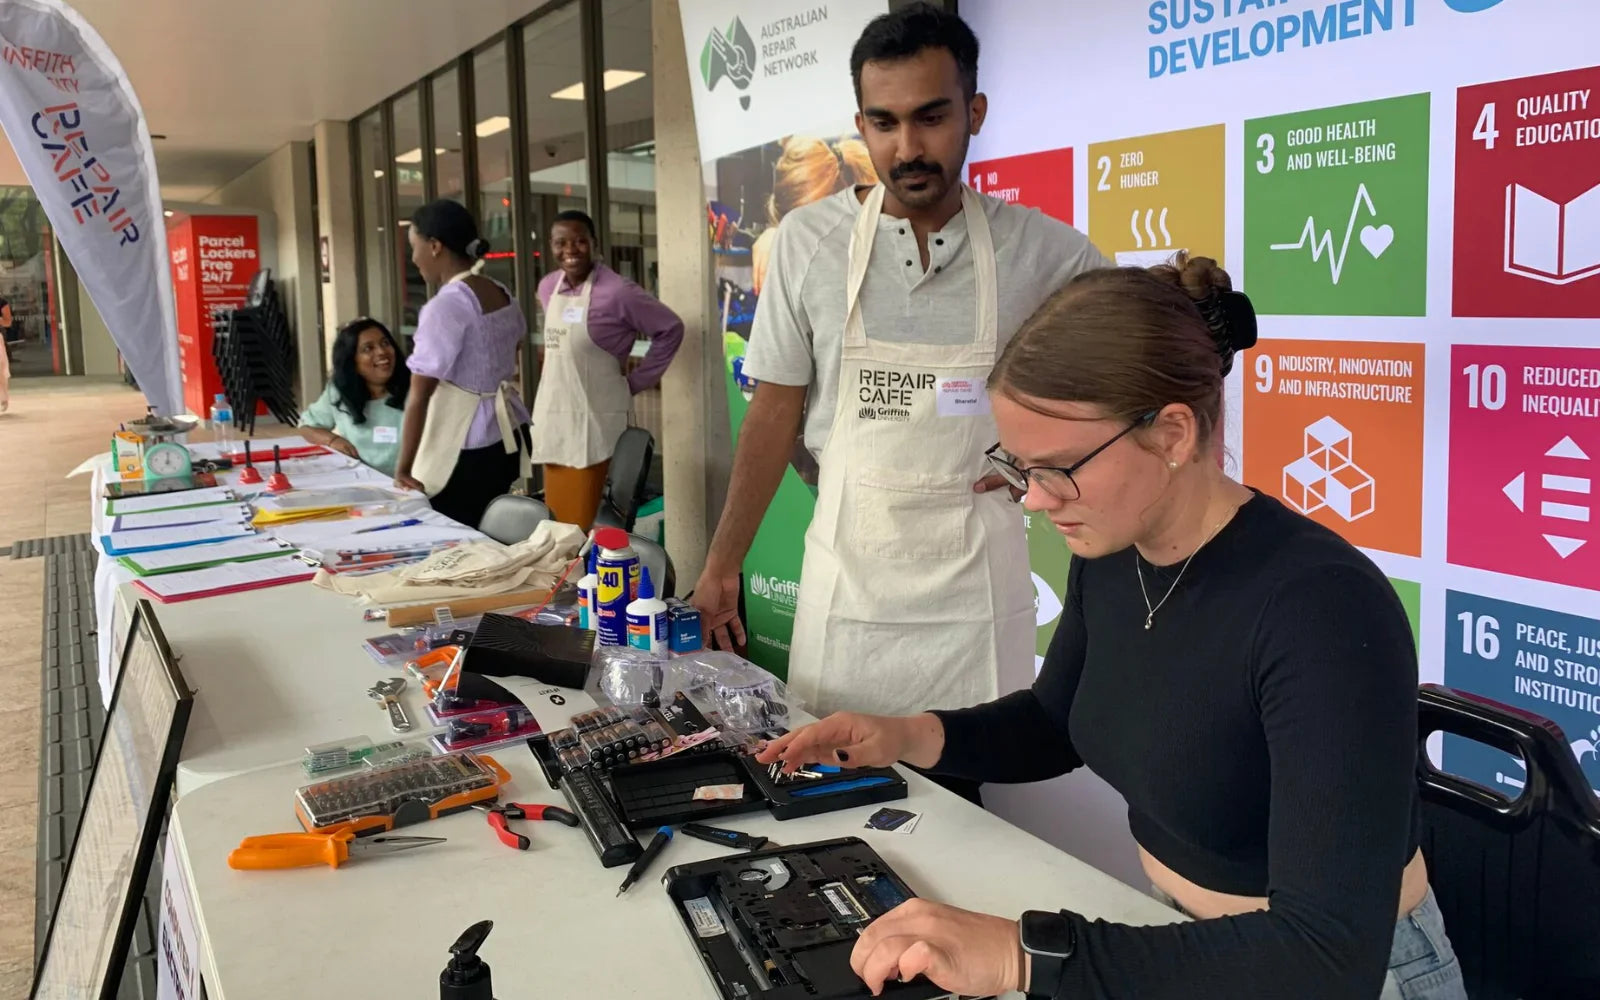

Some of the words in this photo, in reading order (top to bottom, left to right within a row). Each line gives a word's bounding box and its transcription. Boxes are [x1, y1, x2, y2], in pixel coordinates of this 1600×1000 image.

[761, 5, 828, 39] AUSTRALIAN
[762, 36, 796, 58] REPAIR
[1149, 0, 1415, 79] DEVELOPMENT
[763, 50, 819, 77] NETWORK
[1516, 89, 1591, 120] QUALITY
[1287, 126, 1322, 147] GOOD
[1326, 119, 1376, 142] HEALTH
[1472, 102, 1499, 150] 4
[1516, 118, 1600, 147] EDUCATIO
[1119, 151, 1144, 168] ZERO
[1256, 133, 1275, 174] 3
[1286, 153, 1312, 171] AND
[1316, 142, 1396, 168] WELL-BEING
[973, 174, 982, 193] 1
[987, 171, 998, 186] NO
[1097, 155, 1111, 192] 2
[1120, 171, 1159, 189] HUNGER
[199, 235, 245, 247] Parcel
[200, 248, 256, 259] Lockers
[201, 260, 233, 270] Free
[202, 271, 233, 282] 24/7
[860, 369, 936, 389] REPAIR
[1255, 354, 1273, 393] 9
[1278, 355, 1337, 376] INDUSTRY,
[1339, 357, 1413, 378] INNOVATION
[1523, 366, 1600, 388] REDUCED
[860, 387, 912, 406] CAFE
[1278, 379, 1302, 396] AND
[1305, 380, 1412, 404] INFRASTRUCTURE
[1463, 364, 1507, 411] 10
[877, 407, 910, 417] Griffith
[1522, 394, 1600, 418] INEQUALI
[1457, 611, 1500, 660] 16
[1516, 622, 1571, 654] PEACE,
[1515, 650, 1549, 673] AND
[1554, 658, 1600, 687] STRO
[1515, 675, 1600, 715] INSTITUTIO
